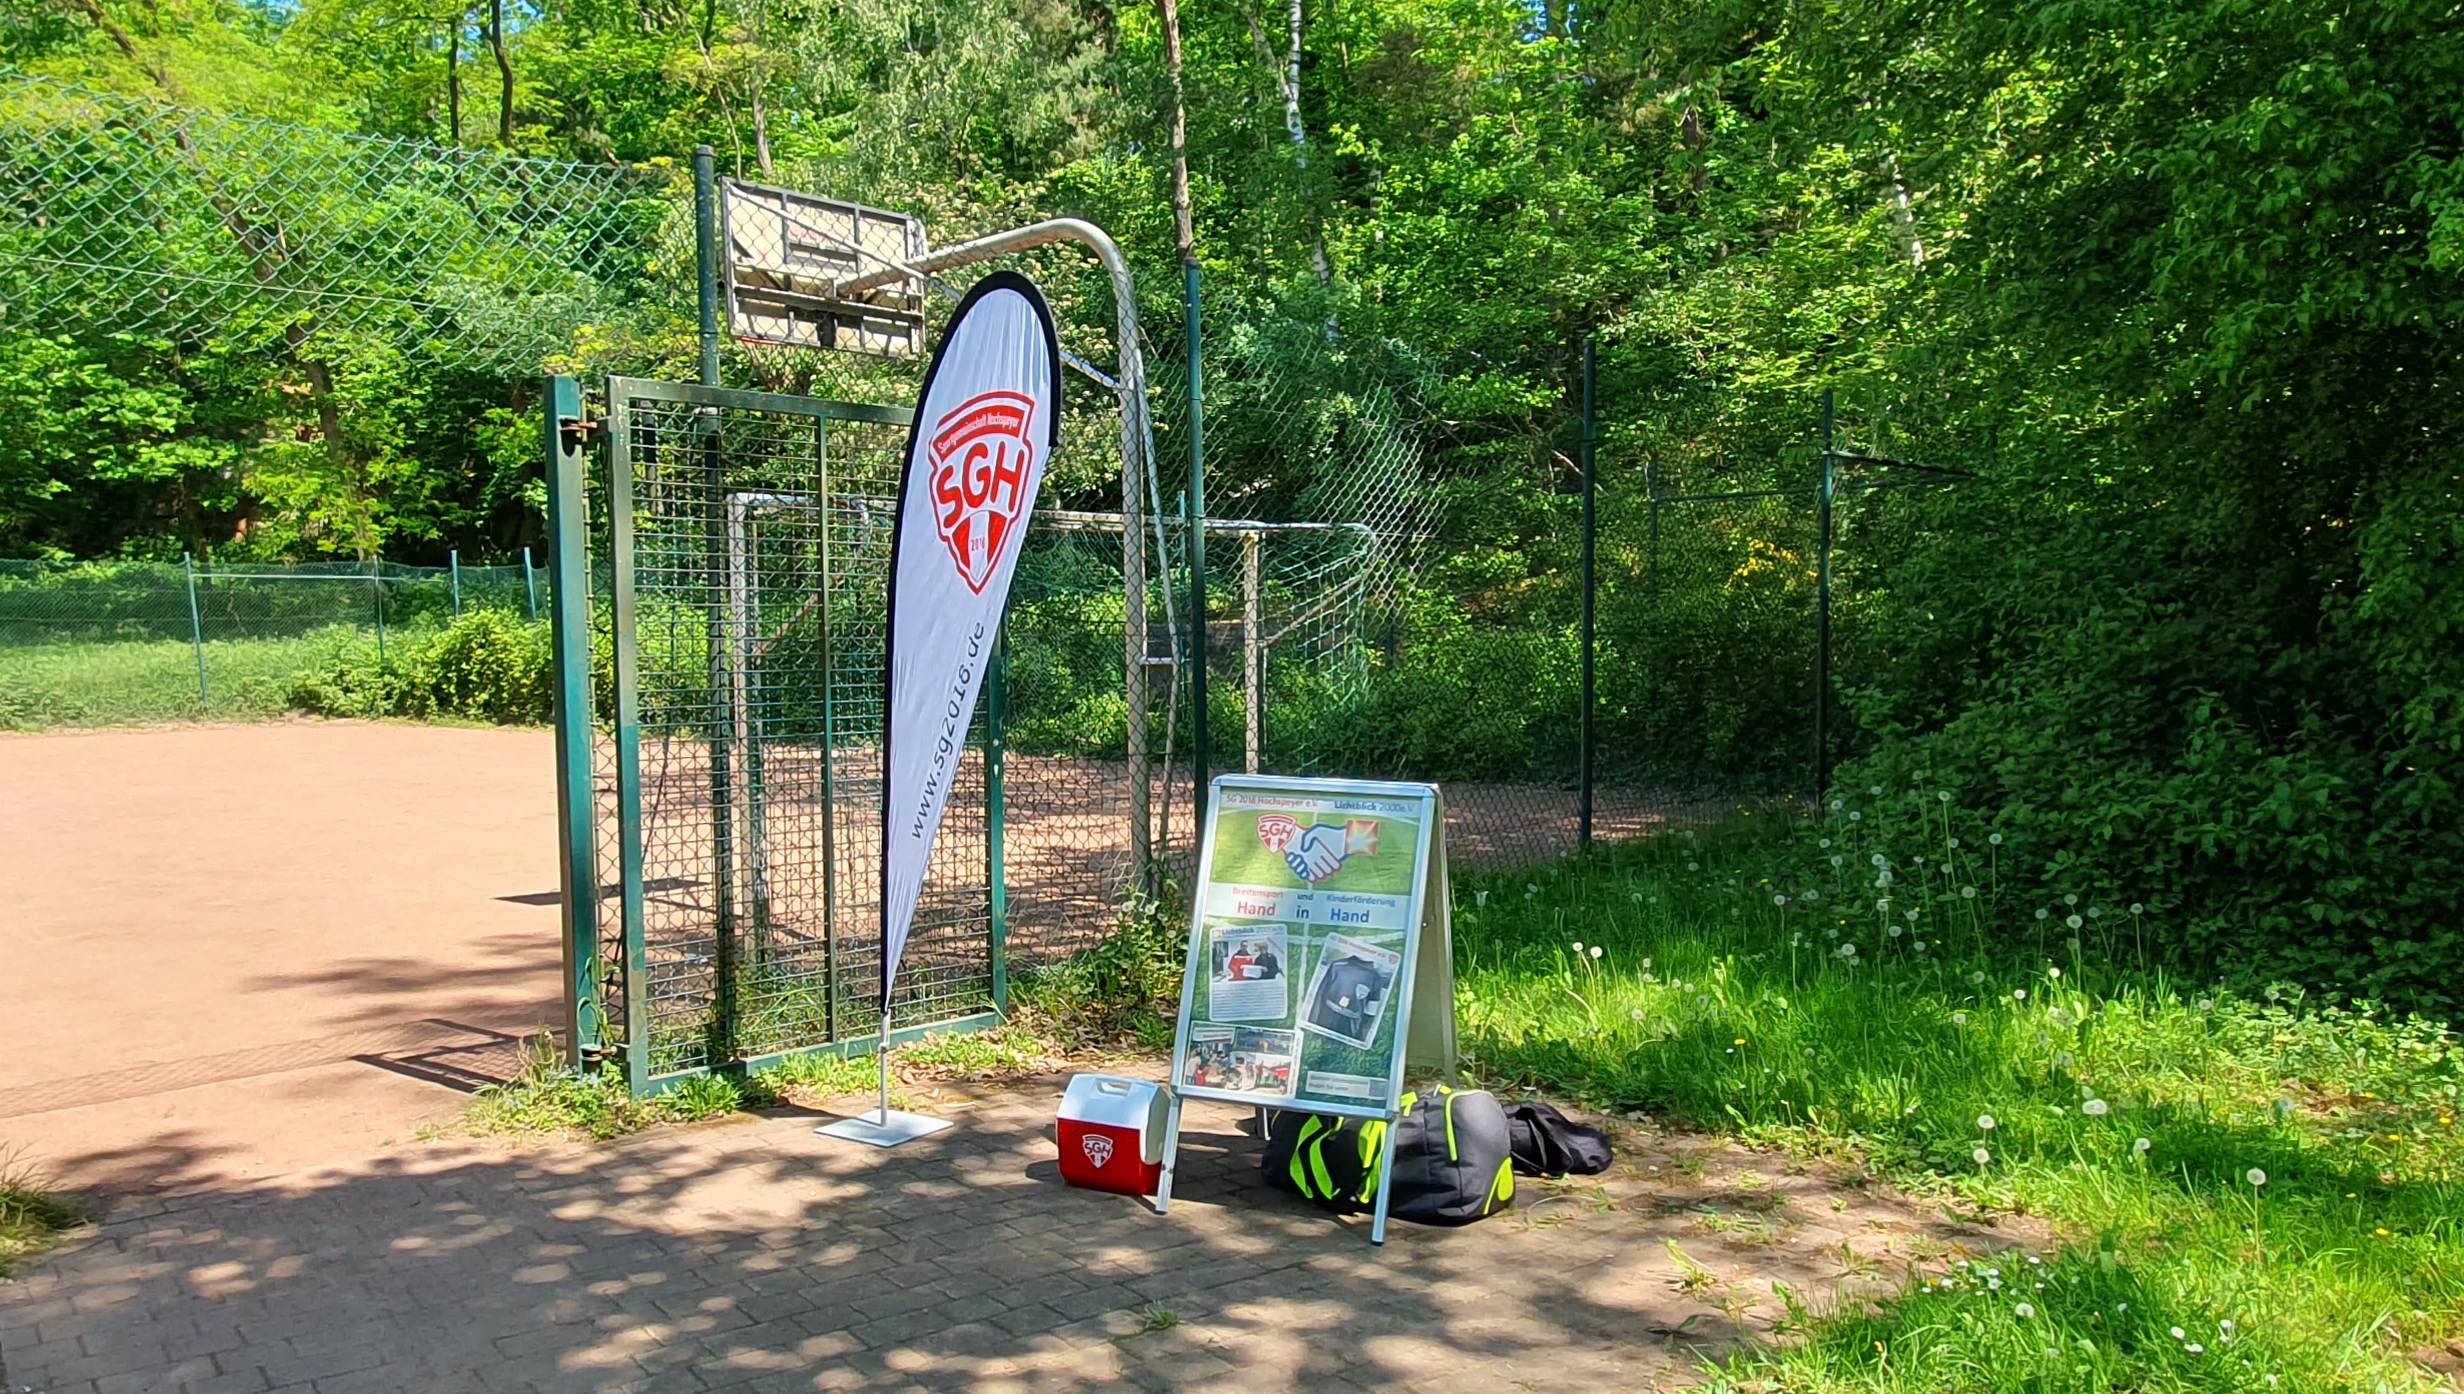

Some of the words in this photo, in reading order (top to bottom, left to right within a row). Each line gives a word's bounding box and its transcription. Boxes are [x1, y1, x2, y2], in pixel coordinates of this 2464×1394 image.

[936, 441, 1025, 529] SGH
[912, 622, 985, 840] www.sg2016.de
[1226, 794, 1237, 803] SG
[1335, 800, 1377, 811] Lichtblick
[1259, 822, 1293, 840] SGH
[1232, 887, 1284, 899] Breitensport
[1297, 892, 1314, 901] und
[1327, 894, 1396, 907] Kinderförderung
[1237, 901, 1276, 916] Hand
[1296, 905, 1310, 919] in
[1330, 908, 1370, 923] Hand
[1084, 1142, 1111, 1158] SGH
